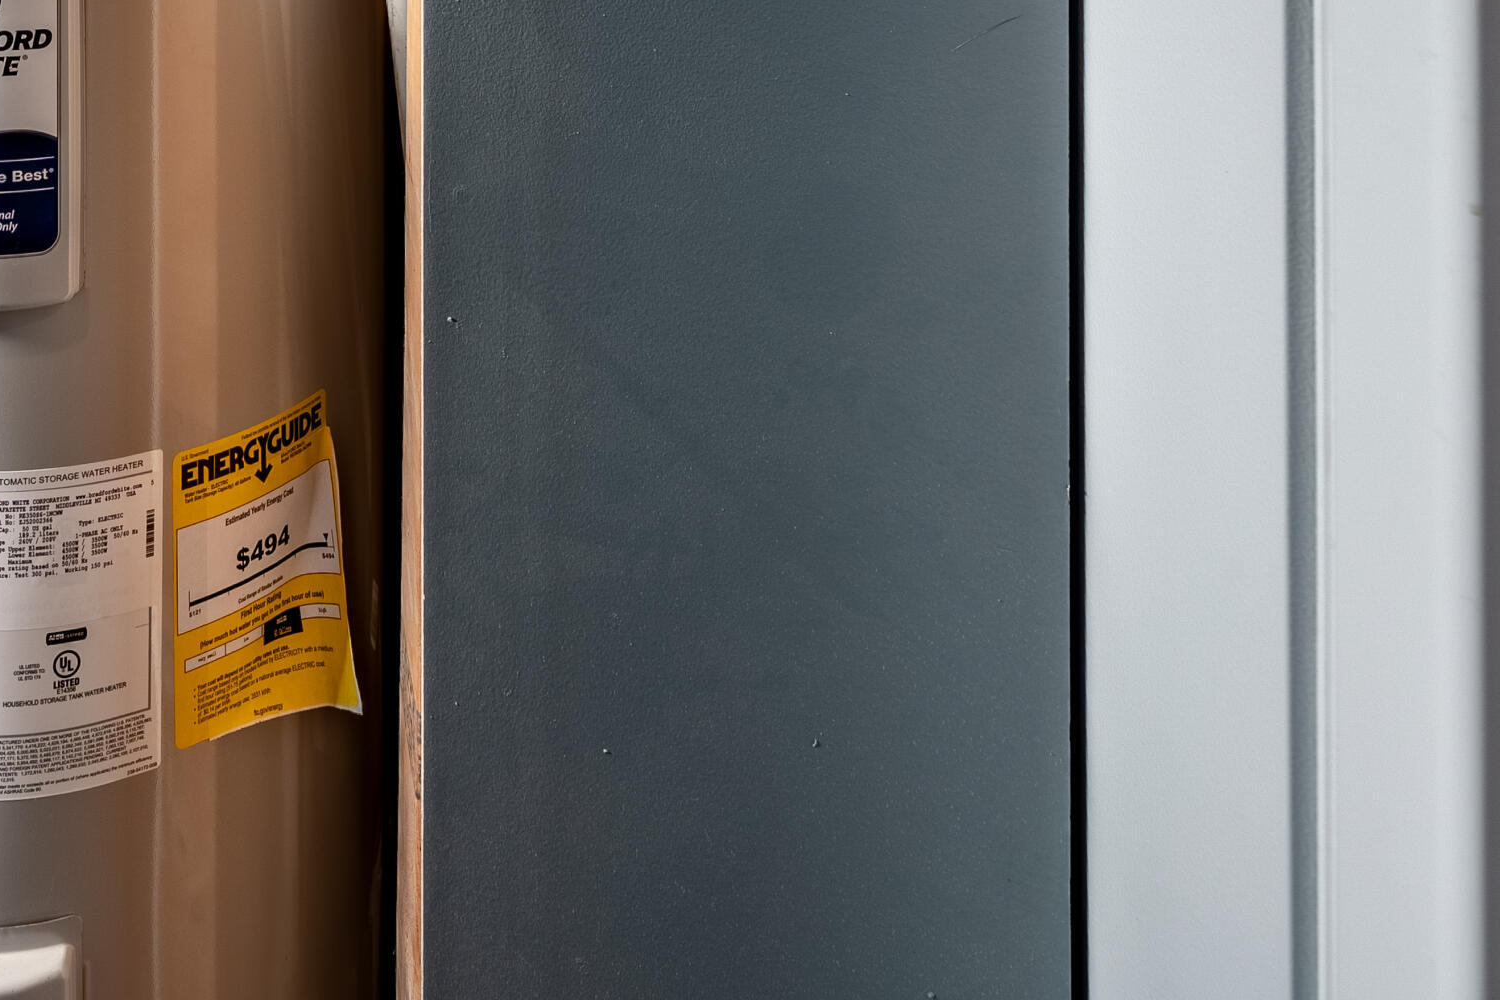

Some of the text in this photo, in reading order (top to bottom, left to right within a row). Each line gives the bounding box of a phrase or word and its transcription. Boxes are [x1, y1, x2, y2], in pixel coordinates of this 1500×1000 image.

[181, 402, 322, 490] ENERGYGUIDE
[38, 472, 79, 484] STORAGE
[81, 467, 110, 478] WATER
[112, 460, 144, 473] HEATER
[98, 512, 124, 523] ELECTRIC
[225, 486, 294, 526] Estimated Yearly Energy Cost
[236, 524, 290, 571] $494
[253, 600, 266, 613] Hour
[266, 591, 282, 608] Rating
[291, 593, 304, 602] hour
[60, 656, 74, 672] UL
[2, 682, 128, 708] HOUSEHOLD STORAGE TANK WATER HEATER
[53, 678, 80, 690] LISTED
